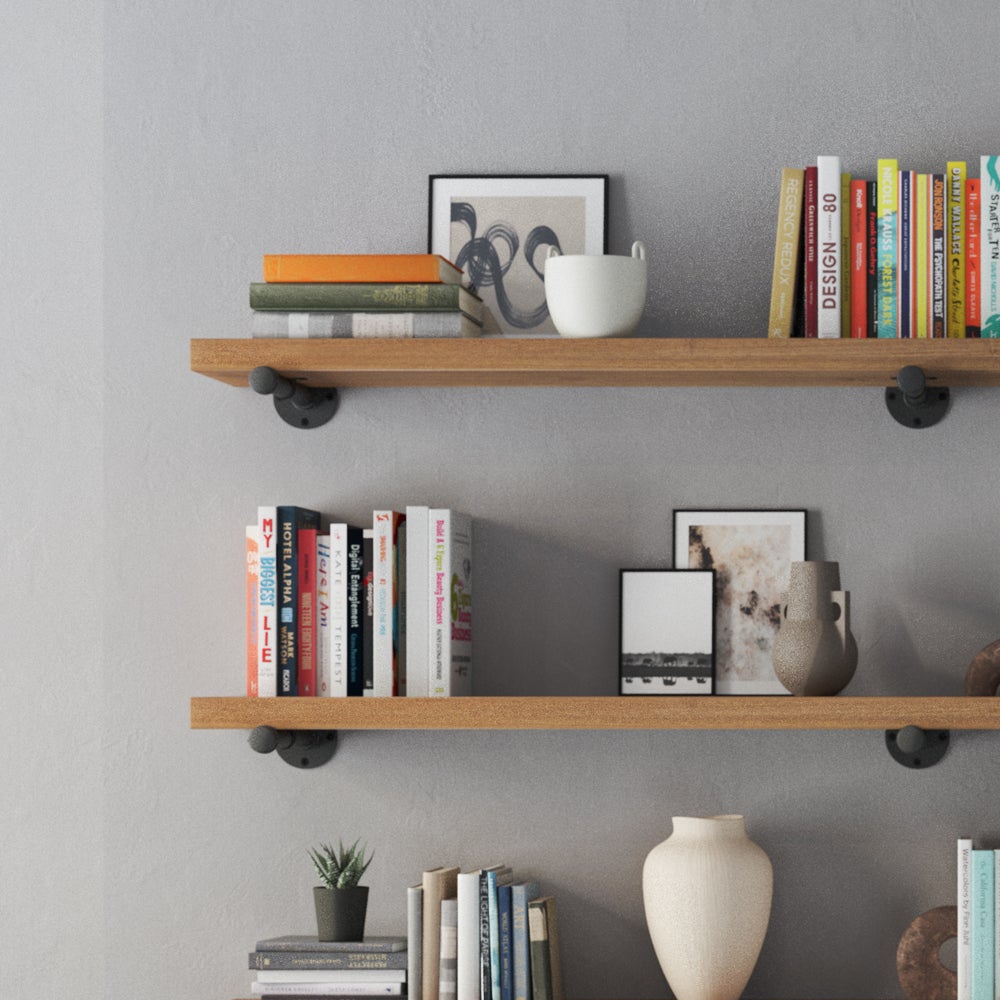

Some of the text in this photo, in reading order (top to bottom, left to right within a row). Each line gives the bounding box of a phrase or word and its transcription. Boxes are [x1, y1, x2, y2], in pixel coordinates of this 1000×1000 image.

[783, 178, 799, 239] REGENCY
[808, 205, 816, 244] GREENWICH
[882, 166, 892, 251] NICOLE KRAUSS
[934, 179, 943, 231] JON RONSON
[951, 168, 961, 255] DANNY WALLACE
[988, 194, 1000, 233] STARTER
[779, 241, 793, 285] REDUX
[822, 194, 837, 309] DESIGN 80
[934, 237, 943, 251] THE
[988, 240, 1000, 260] TEN
[882, 253, 892, 326] FOREST DARK
[934, 252, 943, 300] PSYCHOPATH
[934, 300, 943, 318] TEST
[436, 520, 444, 537] Build
[282, 522, 292, 604] HOTEL ALPHA
[318, 544, 330, 587] Here
[349, 544, 360, 571] Digital
[260, 556, 275, 607] BIGGEST
[349, 574, 360, 628] Entanglement
[434, 572, 444, 596] Beauty
[302, 592, 312, 626] NINETEEN
[320, 601, 329, 628] Am
[436, 596, 444, 625] Business
[480, 876, 488, 894] THE
[962, 848, 970, 898] Watercolors
[480, 895, 488, 921] LIGHT
[514, 906, 525, 930] ART
[962, 900, 970, 910] by
[481, 923, 488, 936] OF
